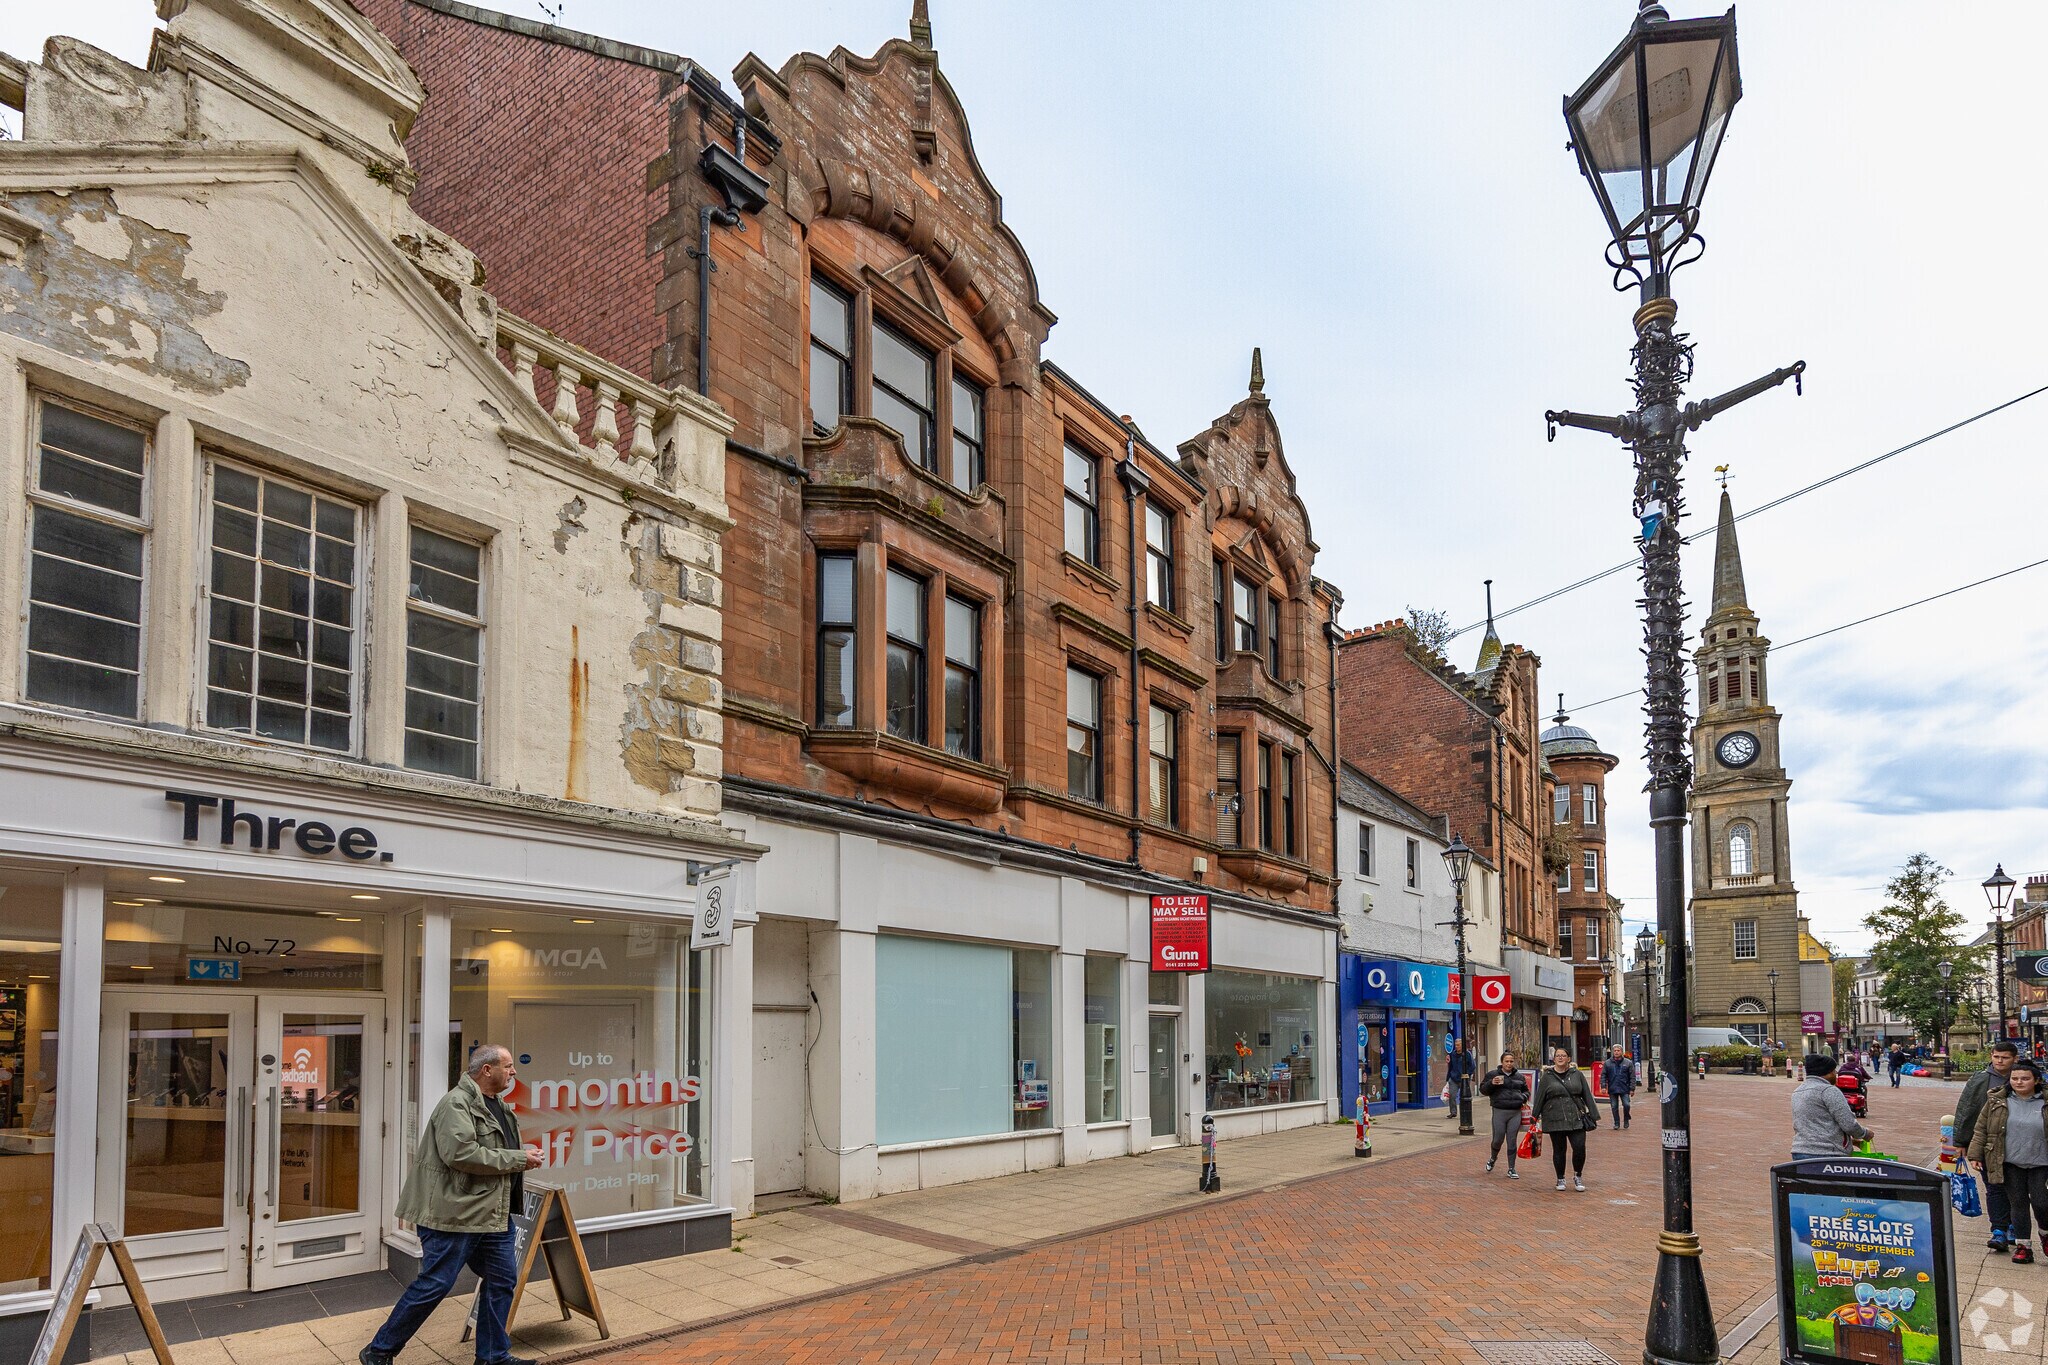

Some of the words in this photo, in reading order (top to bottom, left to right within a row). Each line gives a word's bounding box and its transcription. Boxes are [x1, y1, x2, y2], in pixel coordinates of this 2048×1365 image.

[165, 790, 393, 862] Three.
[704, 886, 721, 928] 3
[1160, 897, 1175, 906] TO
[1178, 896, 1199, 905] LET/
[1154, 908, 1178, 916] MAY
[1181, 907, 1206, 915] SELL
[214, 935, 296, 956] No.72
[1162, 946, 1199, 960] Gunn
[568, 1052, 592, 1068] Up
[596, 1052, 613, 1066] to
[530, 1070, 702, 1109] months
[584, 1127, 694, 1166] Price
[1822, 1164, 1888, 1176] ADMIRAL
[584, 1175, 622, 1192] Data
[627, 1172, 660, 1186] Plan
[1840, 1197, 1877, 1205] ADMIRAL
[1840, 1208, 1862, 1222] Join
[1809, 1216, 1853, 1230] FREE
[1858, 1220, 1914, 1236] SLOTS
[1810, 1228, 1914, 1246] TOURNAMENT
[1836, 1242, 1854, 1250] 27TH
[1855, 1244, 1914, 1256] SEPTEMBER
